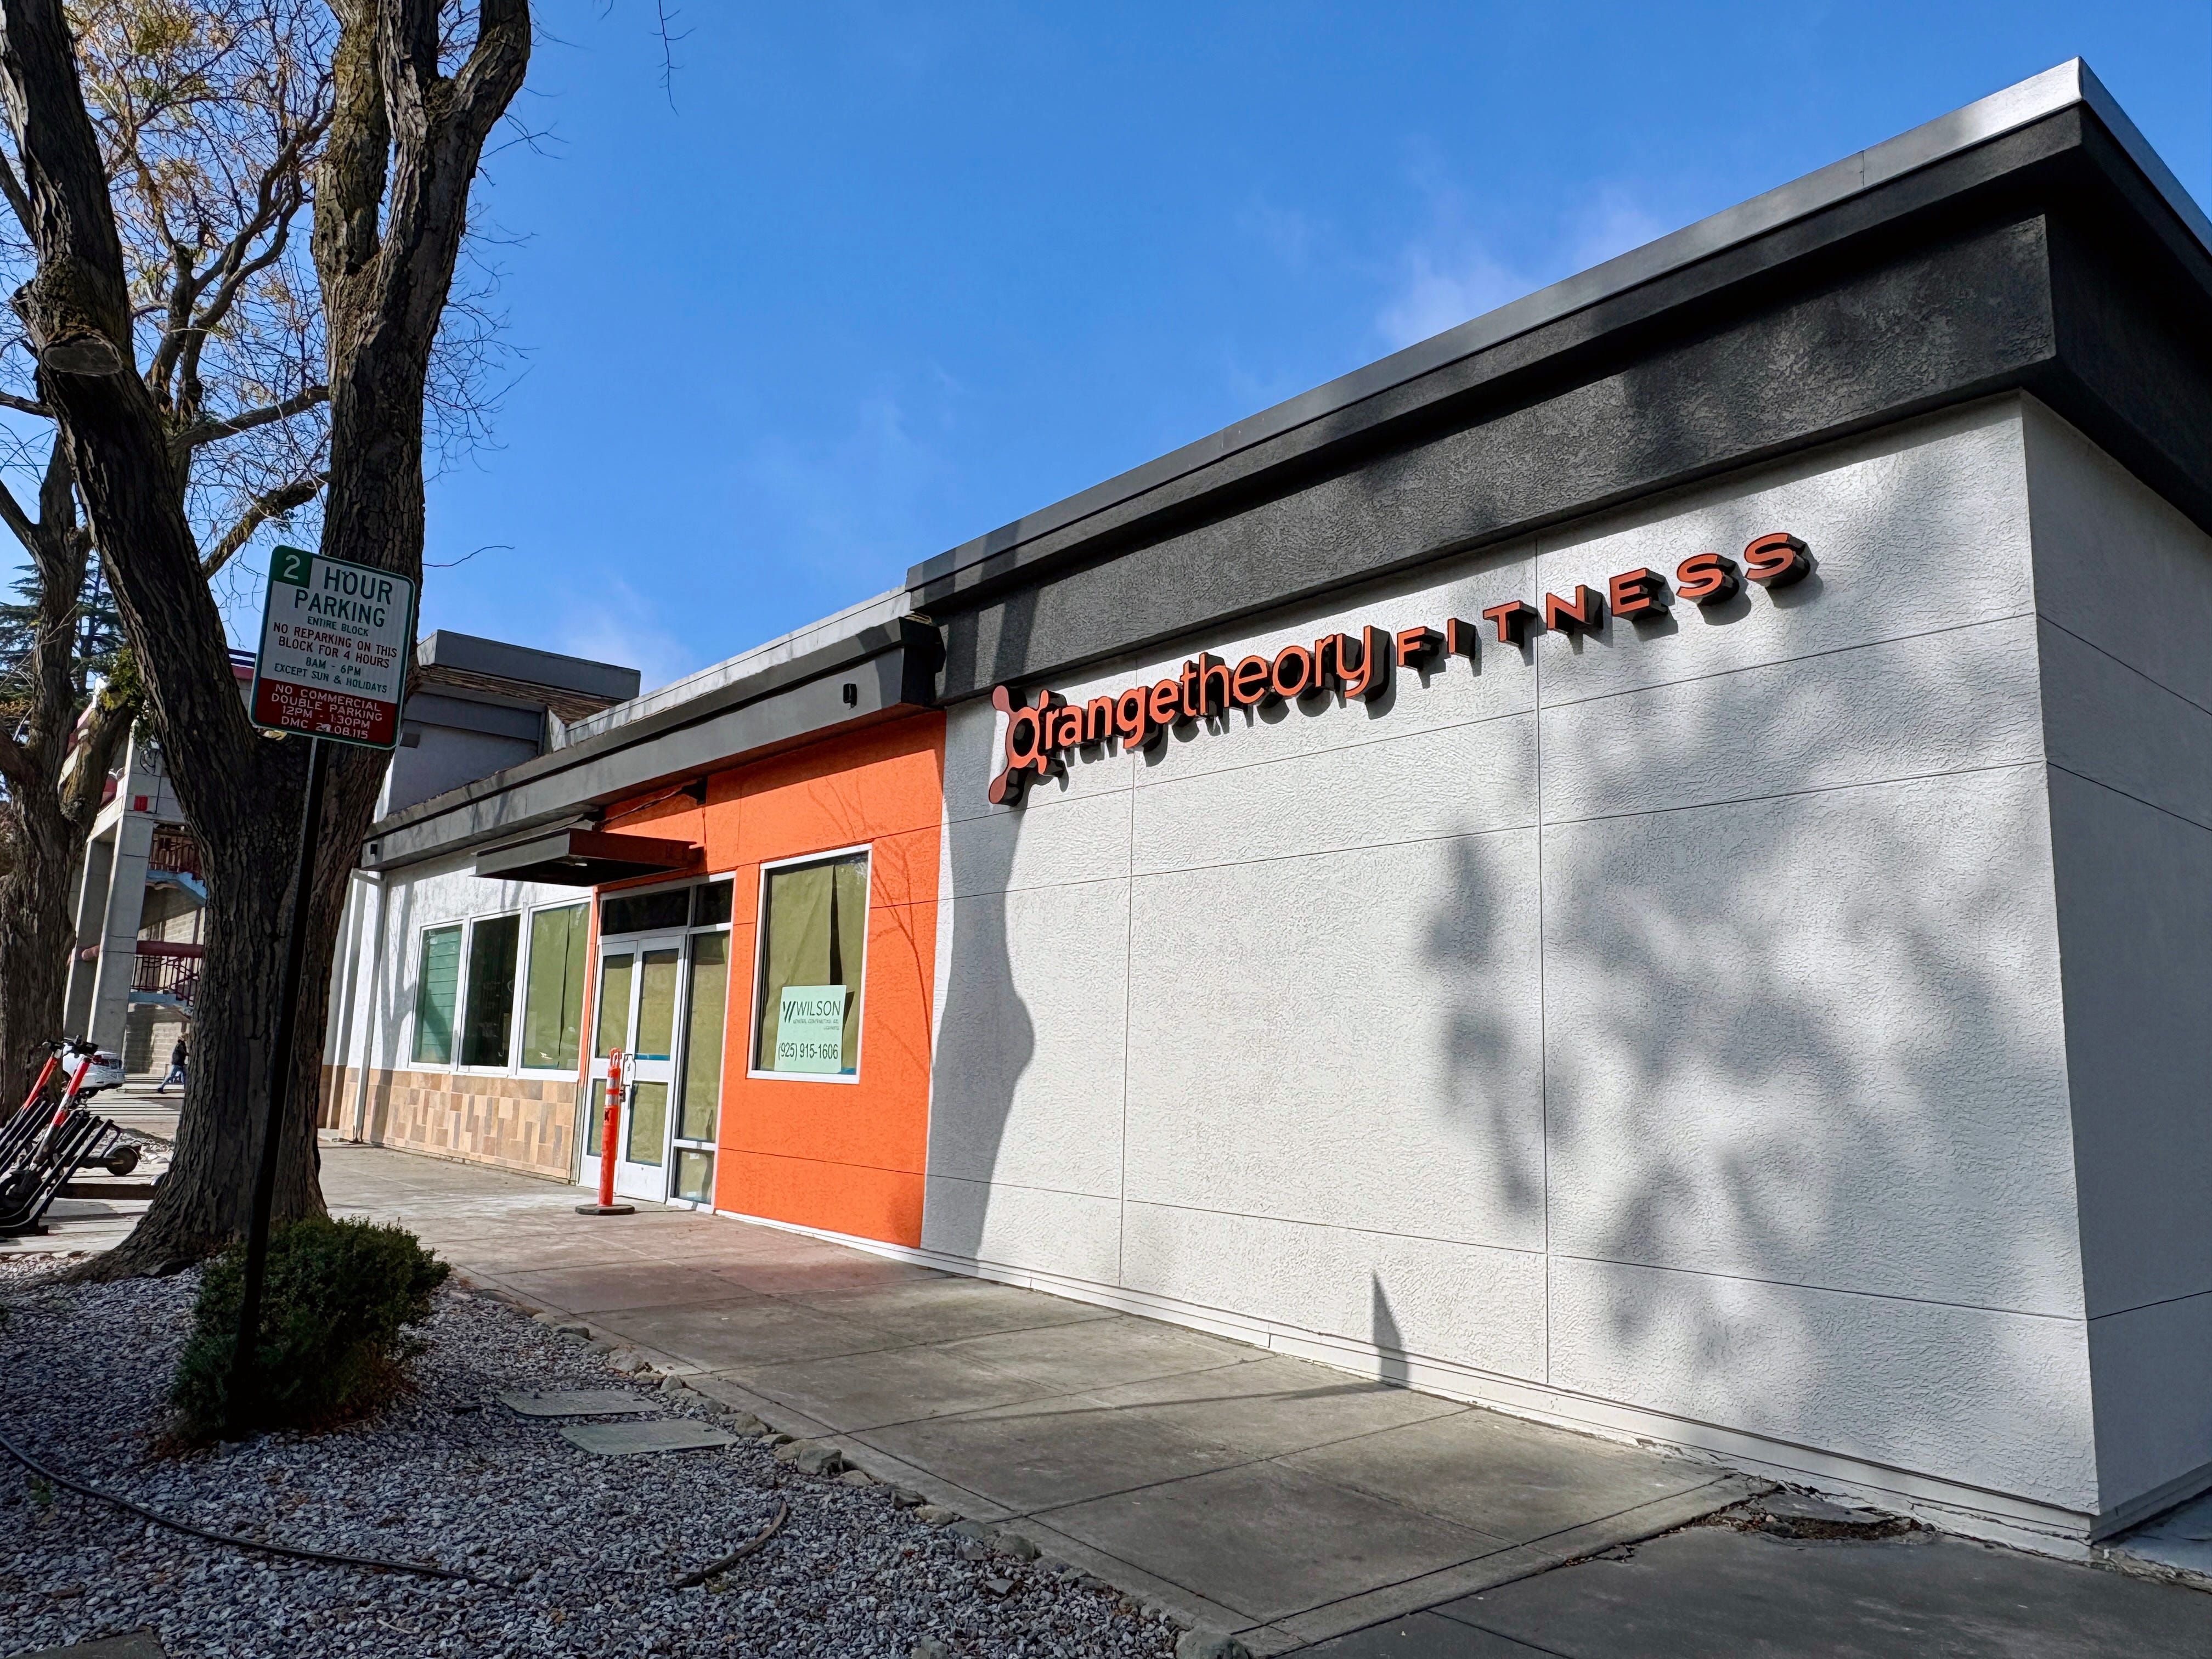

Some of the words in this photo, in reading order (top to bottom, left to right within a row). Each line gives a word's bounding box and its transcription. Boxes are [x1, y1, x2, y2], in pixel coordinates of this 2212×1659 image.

[283, 554, 301, 580] 2
[324, 566, 393, 605] HOUR
[294, 589, 385, 627] PARKING
[1396, 532, 1796, 668] FITNESS
[273, 622, 289, 634] NO
[294, 627, 352, 648] REPARKING
[357, 641, 371, 652] ON
[376, 644, 398, 658] THIS
[307, 616, 337, 630] ENTIRE
[341, 623, 369, 636] BLOCK
[278, 636, 313, 652] BLOCK
[318, 645, 338, 658] FOR
[343, 651, 350, 660] 4
[356, 652, 390, 668] HOURS
[274, 663, 308, 678] EXCEPT
[311, 670, 329, 682] SUN
[334, 675, 342, 685] &
[346, 678, 388, 693] HOLIDAYS
[306, 657, 326, 669] 8AM
[340, 664, 362, 676] 6PM
[271, 693, 323, 711] DOUBLE
[329, 704, 382, 721] PARKING
[275, 684, 293, 695] NO
[300, 689, 381, 712] COMMERCIAL
[283, 705, 313, 719] 12PM
[281, 716, 309, 729] DMC
[795, 1000, 841, 1017] WILSON
[778, 1042, 798, 1061] (925)
[799, 1043, 838, 1059] 915-1606
